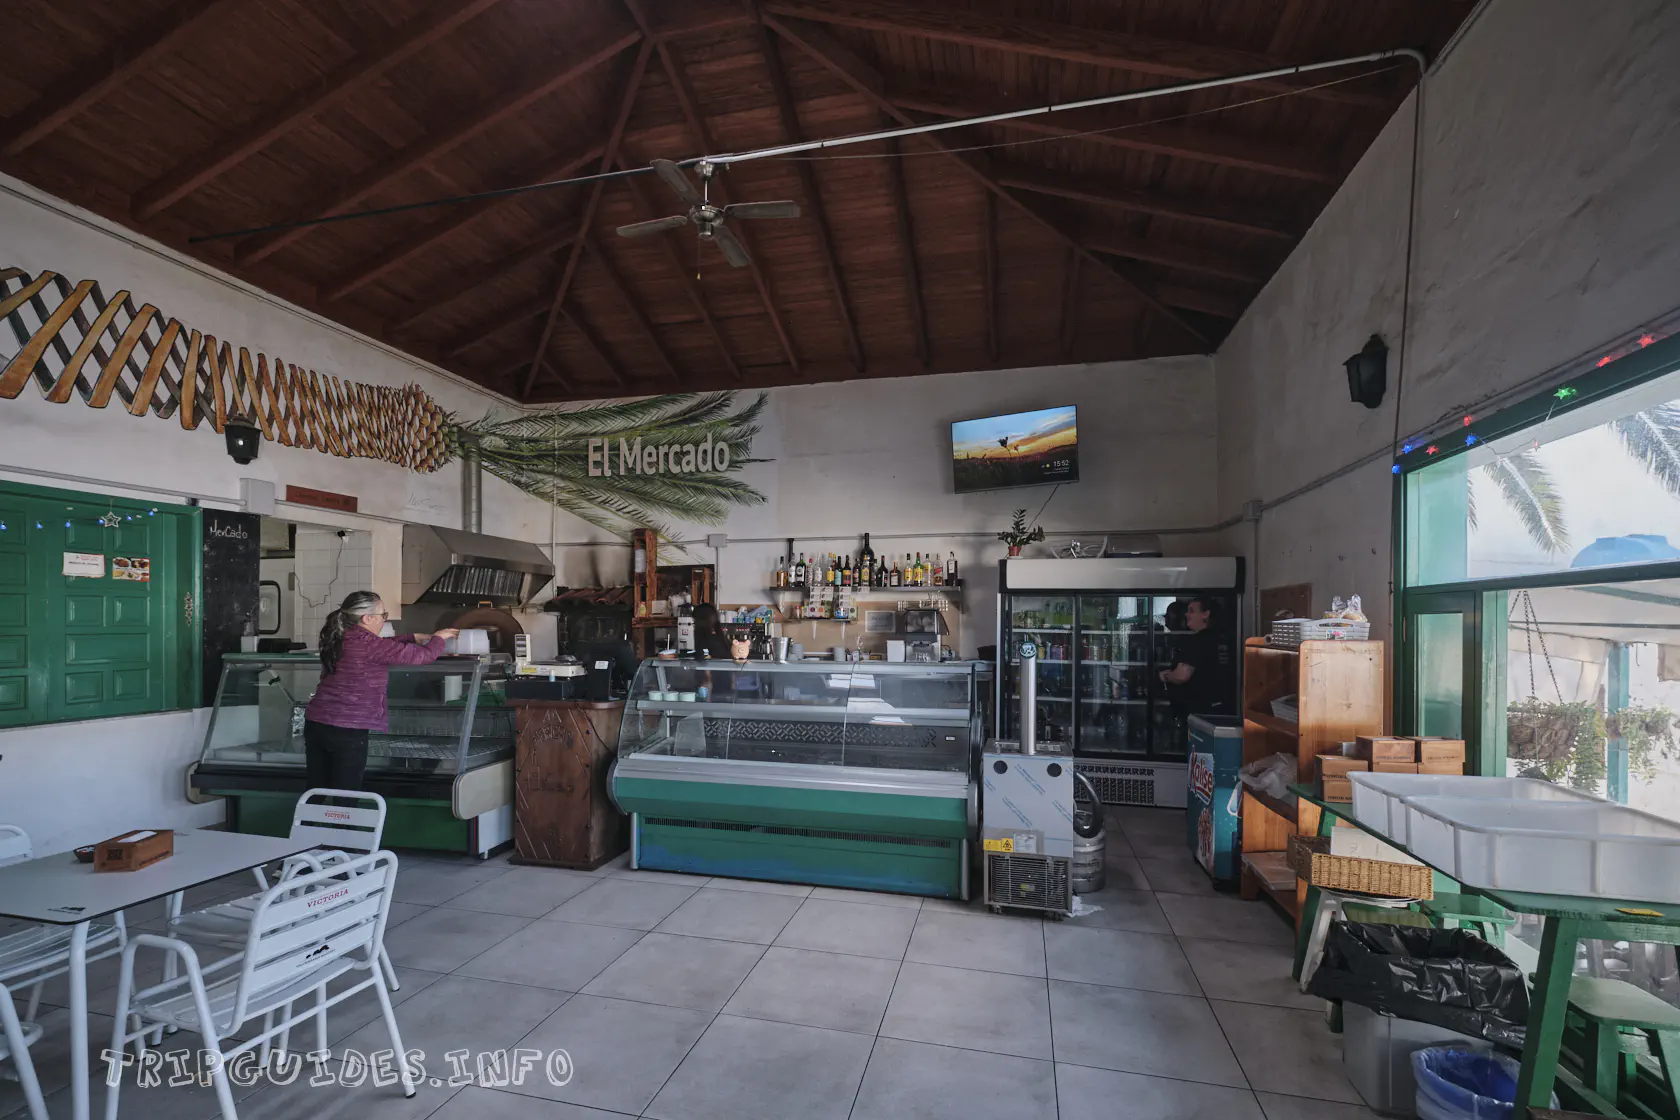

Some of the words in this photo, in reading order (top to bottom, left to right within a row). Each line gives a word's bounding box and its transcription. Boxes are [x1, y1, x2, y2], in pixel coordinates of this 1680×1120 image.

[588, 438, 612, 477] El
[619, 431, 730, 475] Mercado
[1190, 744, 1213, 793] Kalise
[324, 811, 350, 820] VICTORIA
[307, 888, 349, 908] VICTORIA
